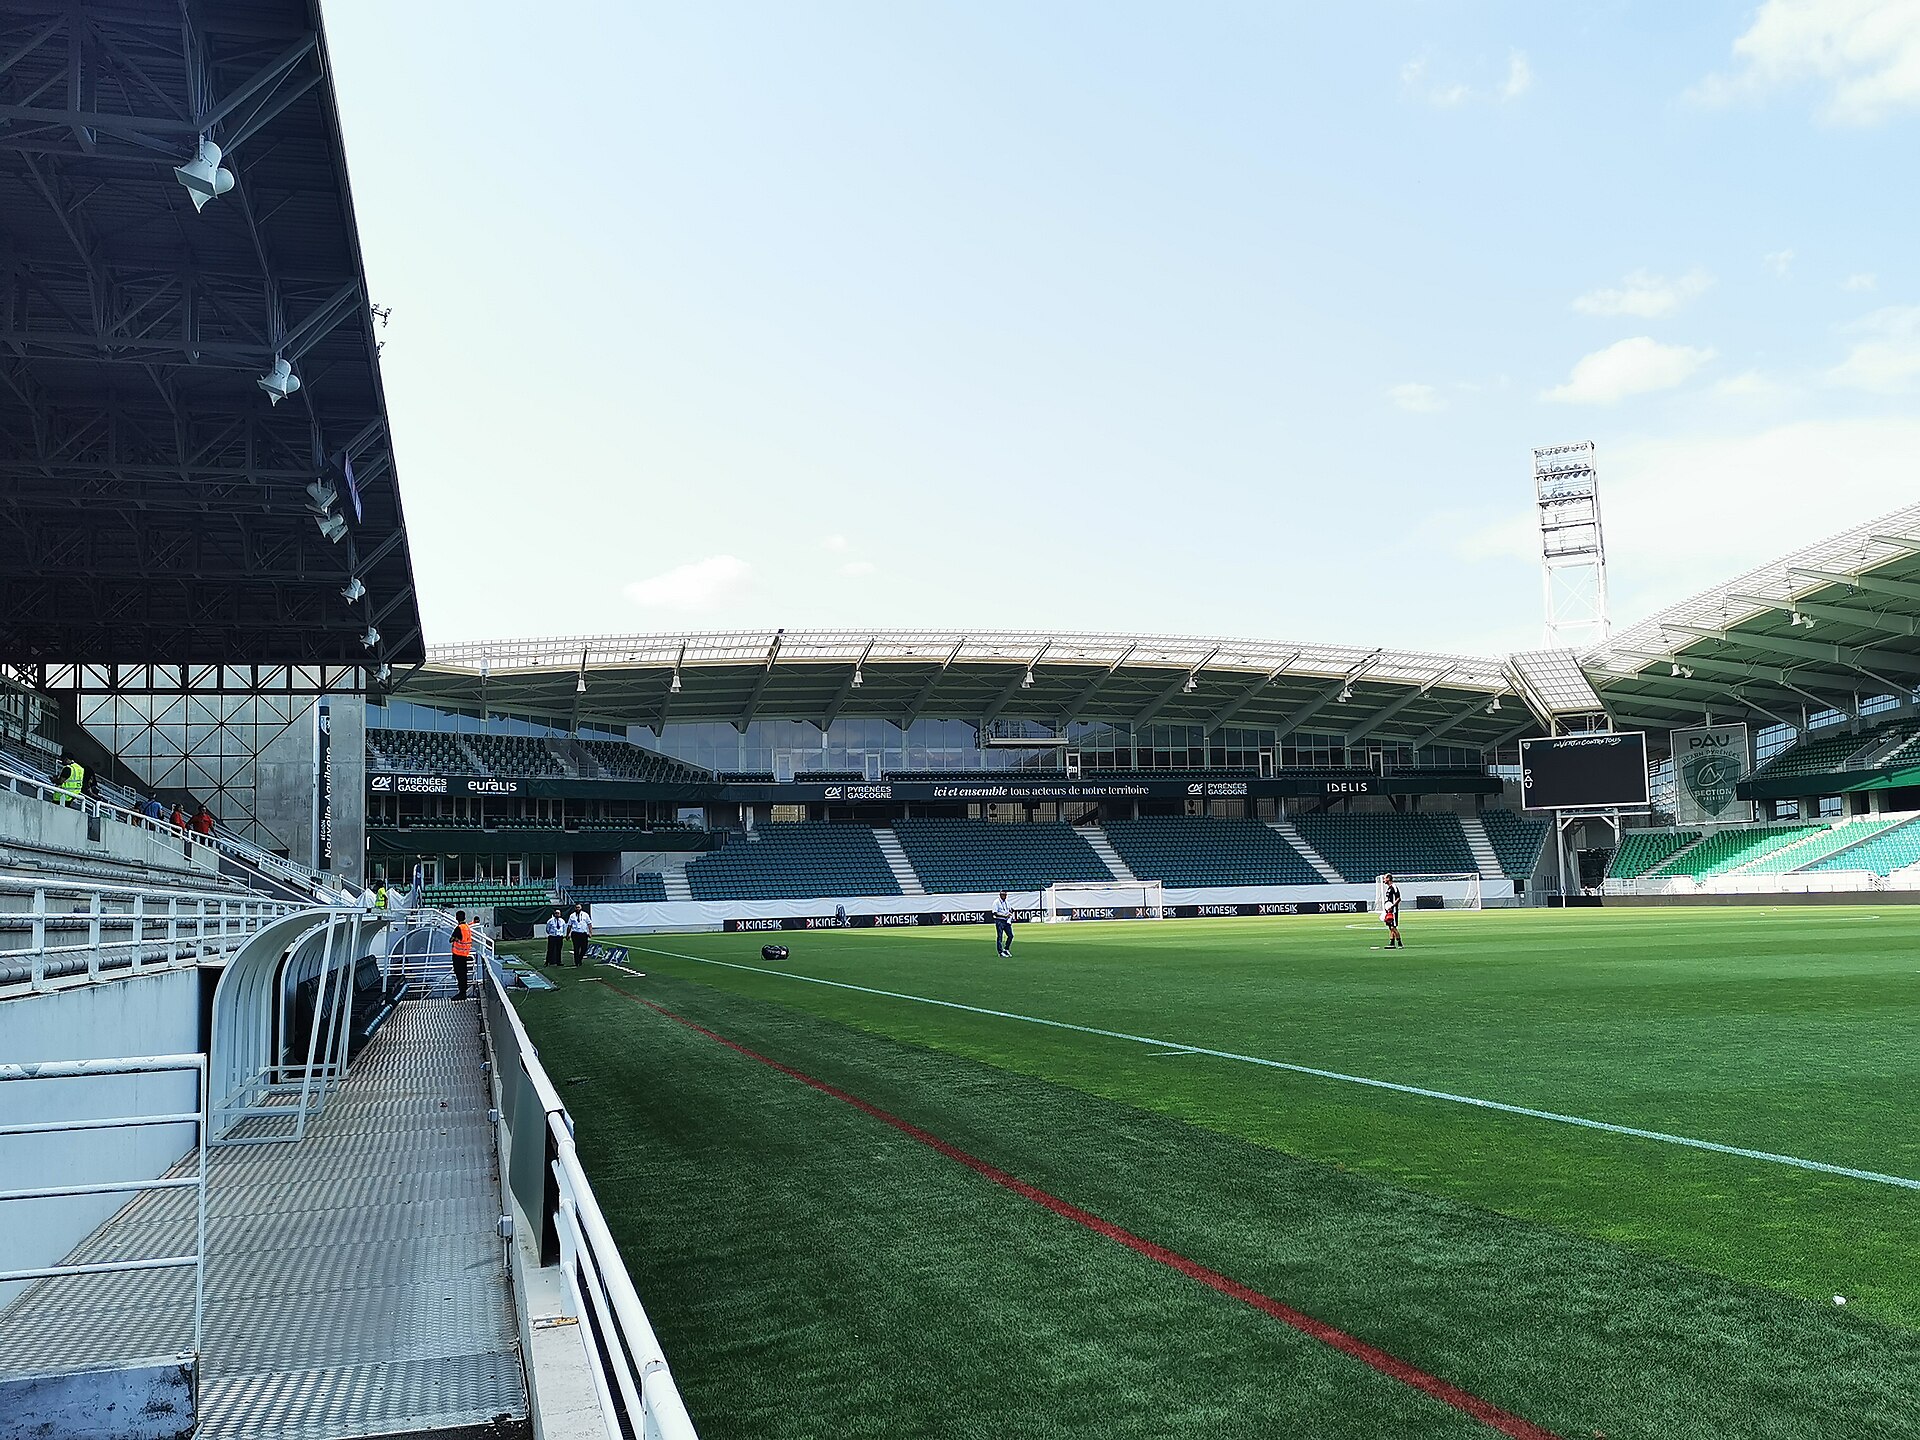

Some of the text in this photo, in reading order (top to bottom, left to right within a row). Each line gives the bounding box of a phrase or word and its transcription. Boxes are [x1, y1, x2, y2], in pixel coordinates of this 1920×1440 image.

[1689, 733, 1730, 749] PAU
[397, 776, 448, 786] PYRÉNÉES
[1524, 769, 1534, 788] PAU
[397, 785, 448, 793] GASCOGNE
[847, 785, 892, 793] PYRÉNÉES
[933, 784, 1150, 797] ici et ensemble tous acteurs de notre territoire
[1326, 782, 1368, 792] IDELIS
[1694, 788, 1732, 797] SECTION
[1205, 905, 1238, 915] KINESIK
[1266, 903, 1298, 913] KINESIK
[1325, 902, 1357, 912] KINESIK
[950, 912, 985, 922] KINESIK
[1080, 908, 1114, 918] KINESIK
[745, 919, 783, 930] KINESIK
[883, 914, 919, 925] KINESIK
